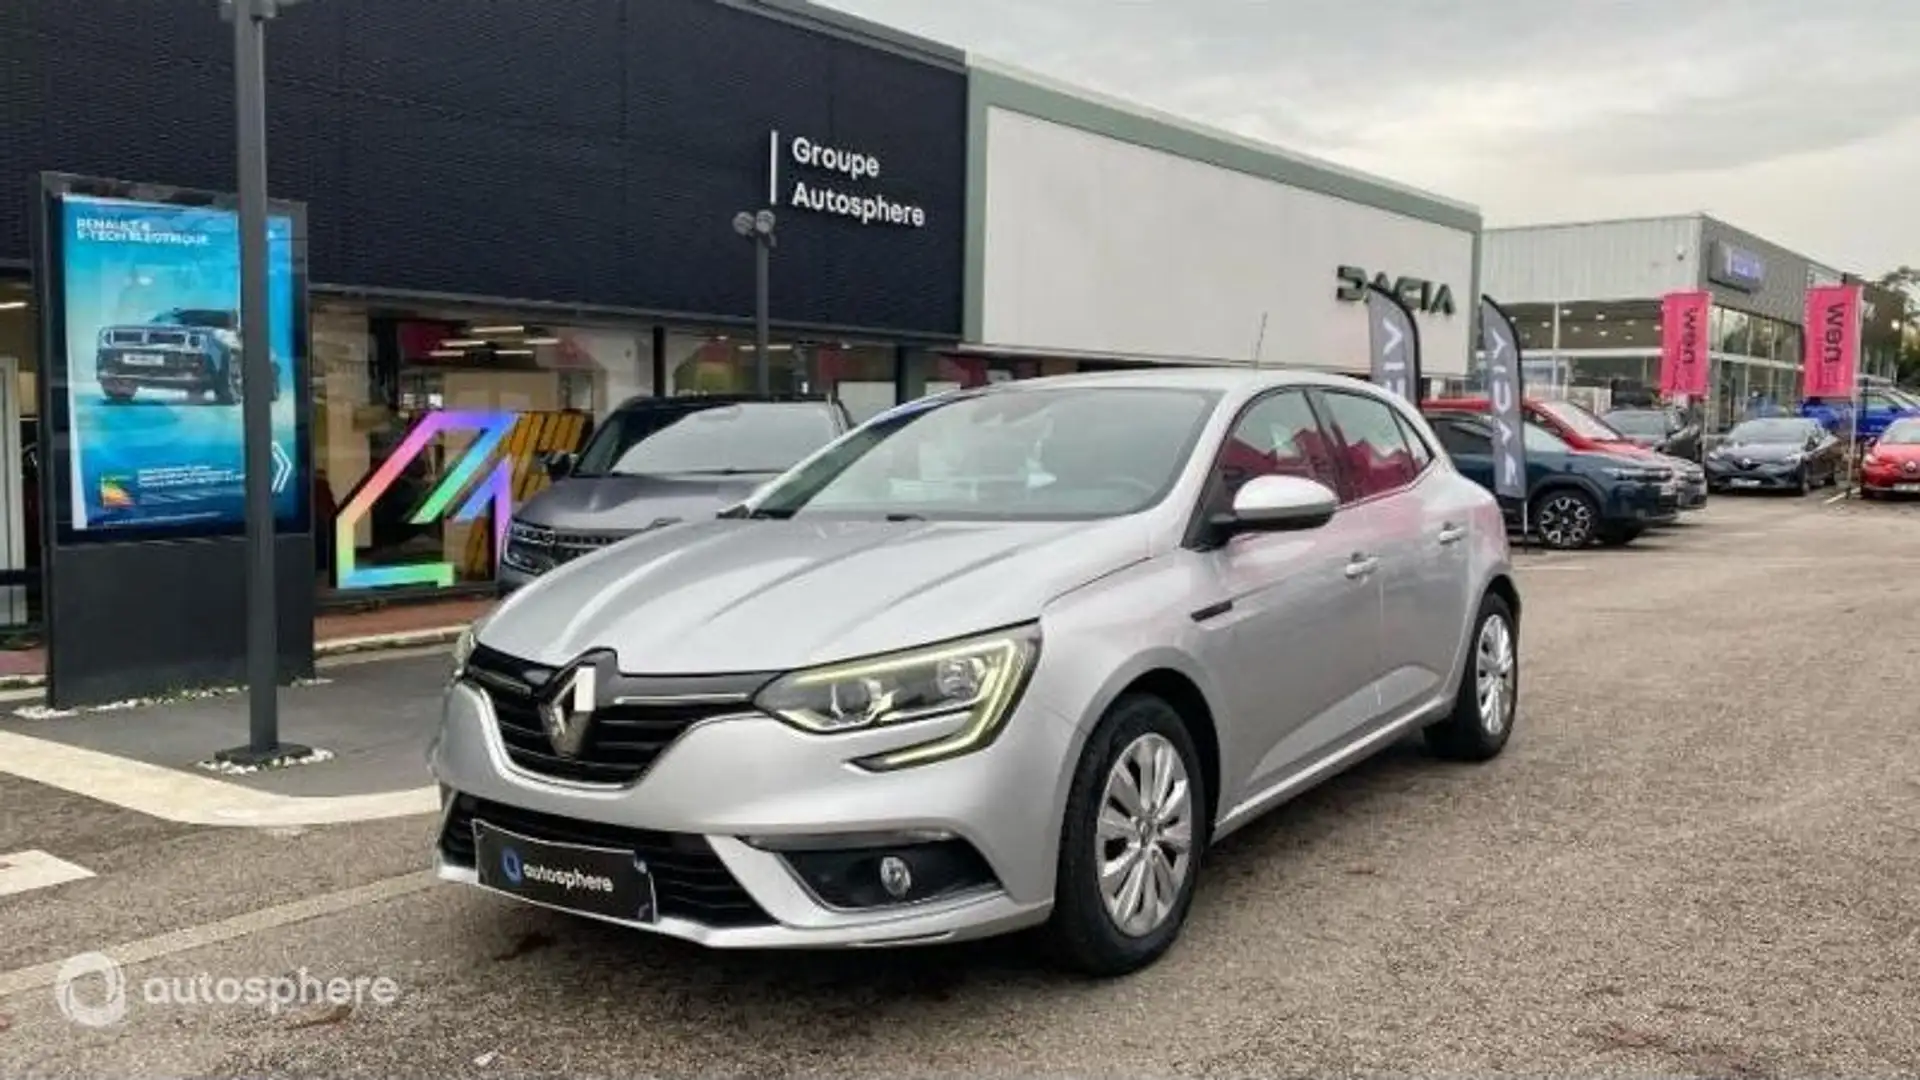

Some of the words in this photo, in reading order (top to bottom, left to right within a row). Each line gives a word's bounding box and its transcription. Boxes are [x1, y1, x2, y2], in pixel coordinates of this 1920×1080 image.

[791, 136, 880, 181] Groupe
[76, 217, 139, 231] RENAULT
[791, 181, 926, 227] Autosphere
[1336, 264, 1456, 316] DACIA
[522, 862, 614, 893] autosphere
